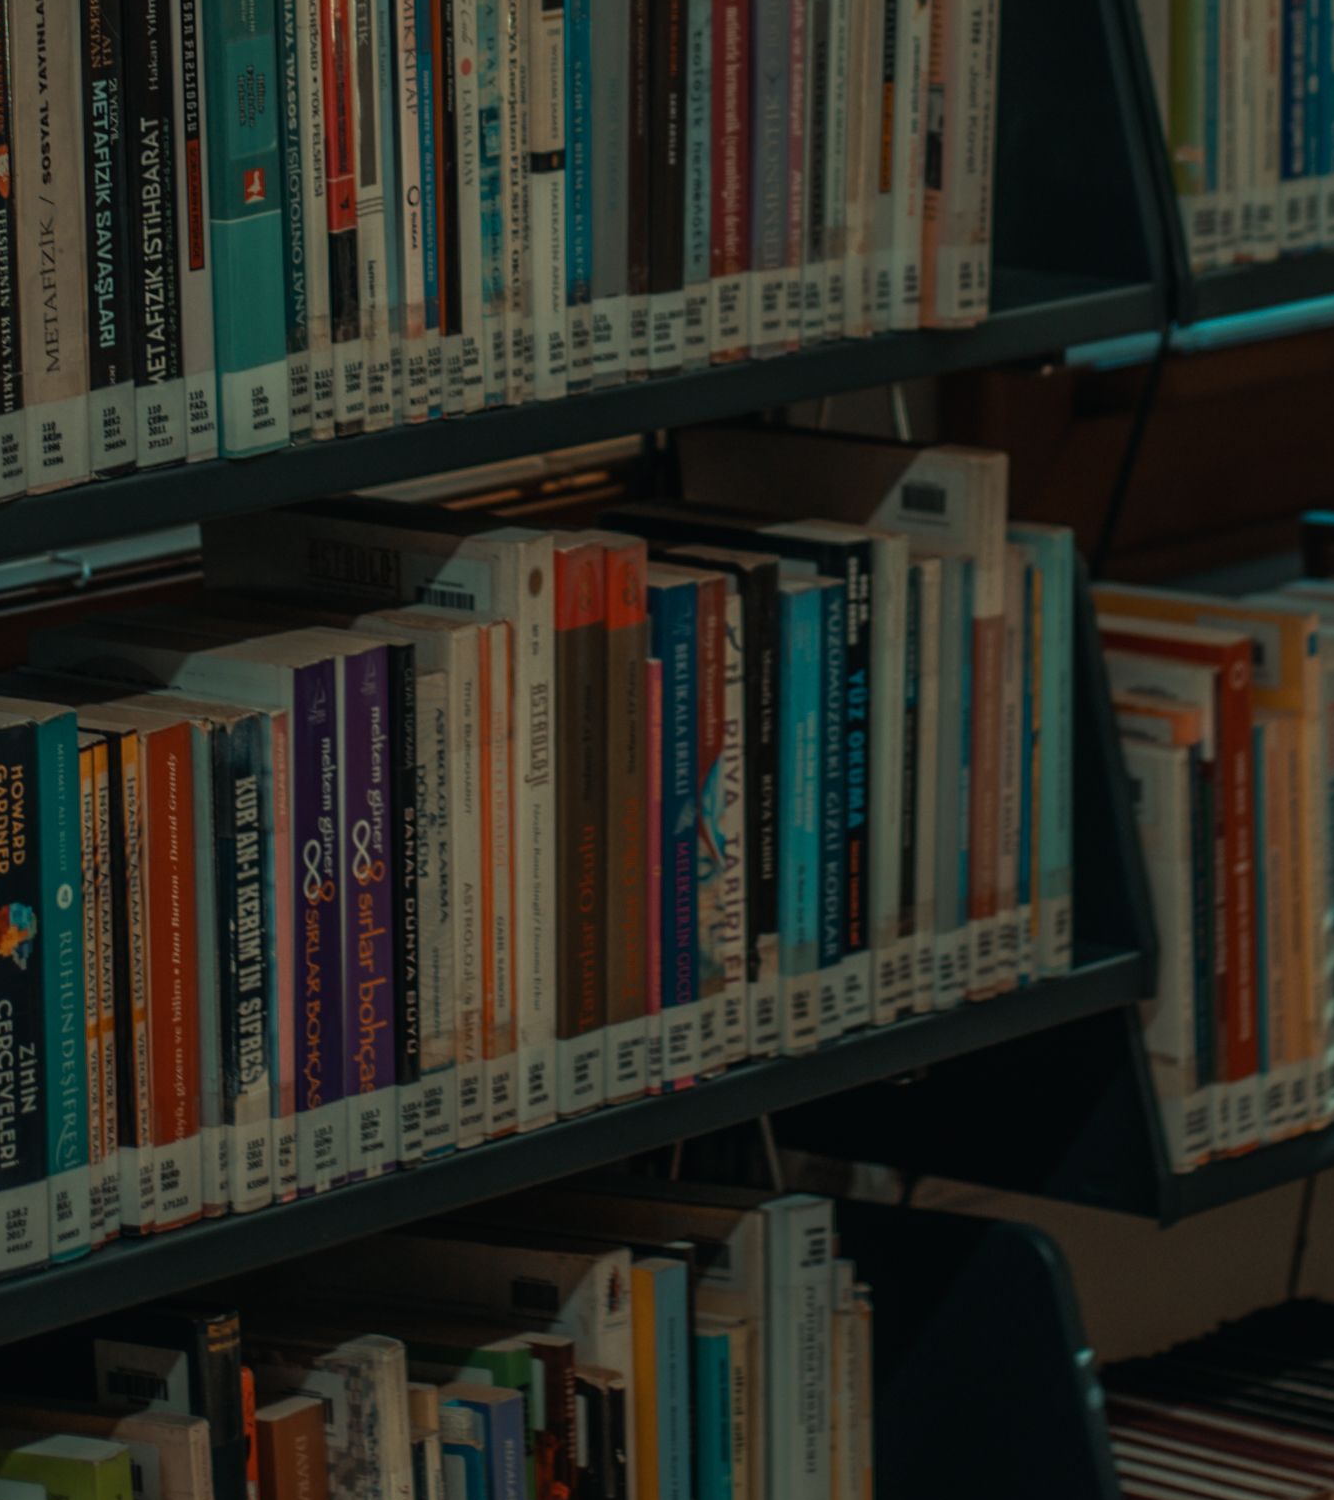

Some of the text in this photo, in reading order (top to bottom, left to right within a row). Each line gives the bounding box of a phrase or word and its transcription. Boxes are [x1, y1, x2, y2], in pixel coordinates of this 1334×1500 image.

[92, 80, 115, 348] METAFİZİK SAVAŞLARI
[237, 998, 262, 1085] ŞİFRES
